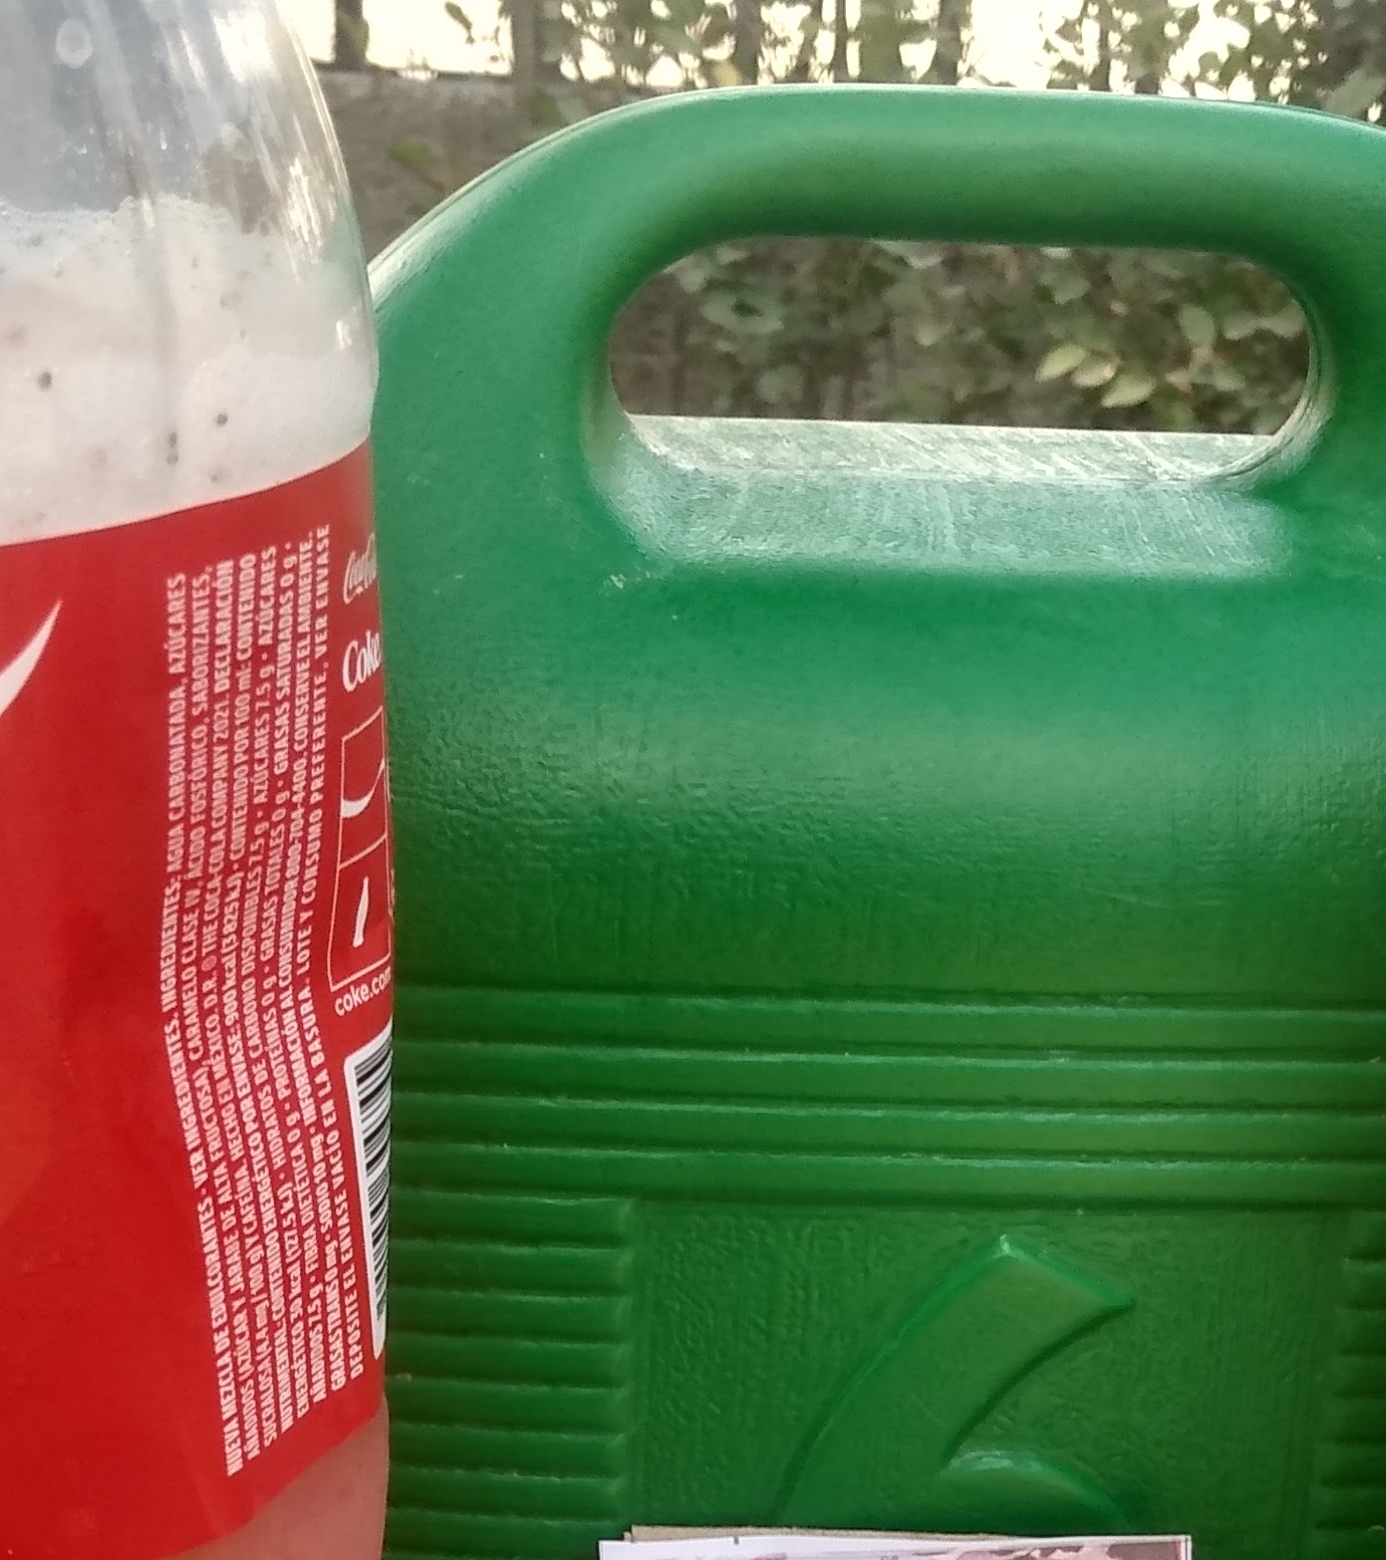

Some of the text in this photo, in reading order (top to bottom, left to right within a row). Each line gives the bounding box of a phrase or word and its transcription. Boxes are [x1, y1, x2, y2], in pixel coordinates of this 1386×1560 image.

[257, 546, 276, 645] AZÚCARES
[315, 525, 329, 609] ENVASE
[167, 573, 186, 673] AZÚCARES
[214, 560, 233, 693] DECLARACIÓN
[237, 554, 255, 659] CONTENIDO
[314, 615, 328, 658] VER
[276, 590, 293, 699] SATURADAS
[274, 702, 289, 774] GRASAS
[294, 659, 310, 751] CONSERVE
[234, 726, 249, 763] POR
[251, 713, 270, 803] AZÚCARES
[212, 745, 228, 827] COMPANY
[230, 765, 248, 860] CONTENIDO
[167, 823, 184, 871] AGUA
[185, 826, 205, 879] ÁCIDO
[204, 828, 226, 920] COCA-COLA
[264, 824, 285, 894] TOTALES
[301, 809, 322, 904] CONSUMO
[225, 872, 243, 902] kJ)
[241, 866, 261, 975] DISPONIBLES
[181, 909, 199, 963] CLASE
[202, 920, 218, 956] THE
[260, 896, 277, 961] GRASAS
[279, 877, 298, 987] CONSUMIDOR
[296, 925, 312, 975] LOTE
[222, 951, 236, 990] kcal
[182, 966, 203, 1060] CARAMELO
[242, 978, 262, 1058] CARBONO
[263, 1008, 291, 1099] PROTEÍNAS
[282, 1009, 316, 1125] INFORMACIÓN
[221, 1103, 244, 1160] HECHO
[240, 1095, 258, 1133] POR
[258, 1085, 285, 1168] HIDRATOS
[190, 1148, 208, 1188] VER
[213, 1161, 232, 1203] ALTA
[248, 1132, 276, 1233] ENERGÉTICO
[290, 1143, 314, 1225] DIETÉTICA
[326, 1130, 344, 1189] VACÍO
[278, 1182, 294, 1214] kJ)
[316, 1182, 332, 1232] SODIO
[334, 1190, 353, 1263] ENVASE
[198, 1197, 227, 1328] EDULCORANTES
[224, 1231, 244, 1293] JARABE
[265, 1231, 285, 1320] CONTENIDO
[287, 1260, 301, 1299] kcal
[303, 1224, 318, 1273] FIBRA
[325, 1279, 341, 1332] TRANS
[345, 1290, 363, 1378] DEPOSITE
[233, 1309, 253, 1380] (AZÚCAR
[291, 1321, 309, 1417] ENERGÉTICO
[309, 1324, 326, 1402] AÑADIDOS
[329, 1328, 345, 1390] GRASAS
[217, 1351, 236, 1419] MEZCLA
[241, 1379, 259, 1459] AÑADIDOS
[258, 1356, 277, 1446] SUCRALOSA
[224, 1418, 242, 1475] NUEVA
